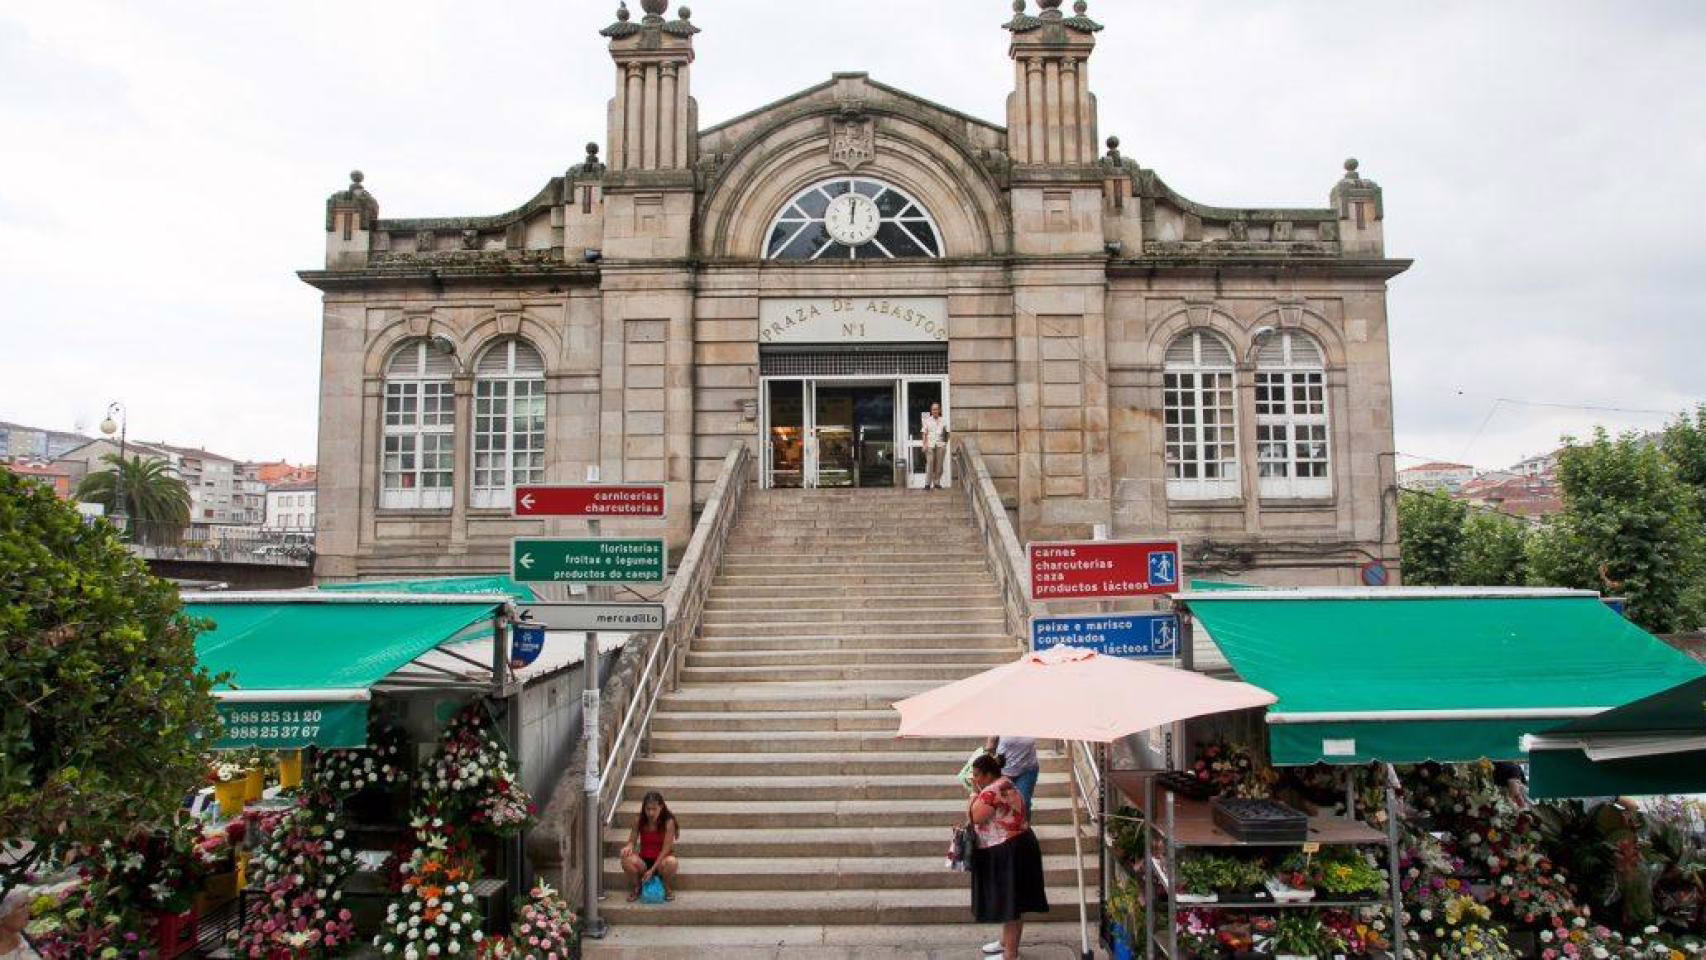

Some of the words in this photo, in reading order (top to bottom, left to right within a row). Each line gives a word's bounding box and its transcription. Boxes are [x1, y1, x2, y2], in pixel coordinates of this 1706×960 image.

[762, 304, 821, 341] PRAZA
[832, 298, 854, 312] DE
[866, 301, 946, 340] ABASTOS
[1035, 549, 1077, 557] carnes
[565, 554, 600, 564] froitas
[605, 557, 612, 565] e
[616, 556, 659, 567] legumes
[1035, 559, 1113, 570] charcuterias
[553, 570, 605, 580] productos
[609, 569, 622, 578] do
[626, 570, 658, 580] campo
[1035, 572, 1065, 582] caza
[1036, 582, 1098, 594] productos
[1103, 580, 1149, 592] lácteos
[596, 613, 658, 623] mercadillo
[1037, 622, 1070, 634] peixe
[1074, 623, 1081, 631] e
[1086, 619, 1133, 630] marisco
[1038, 633, 1105, 645] conxelados
[1103, 642, 1149, 654] lácteos
